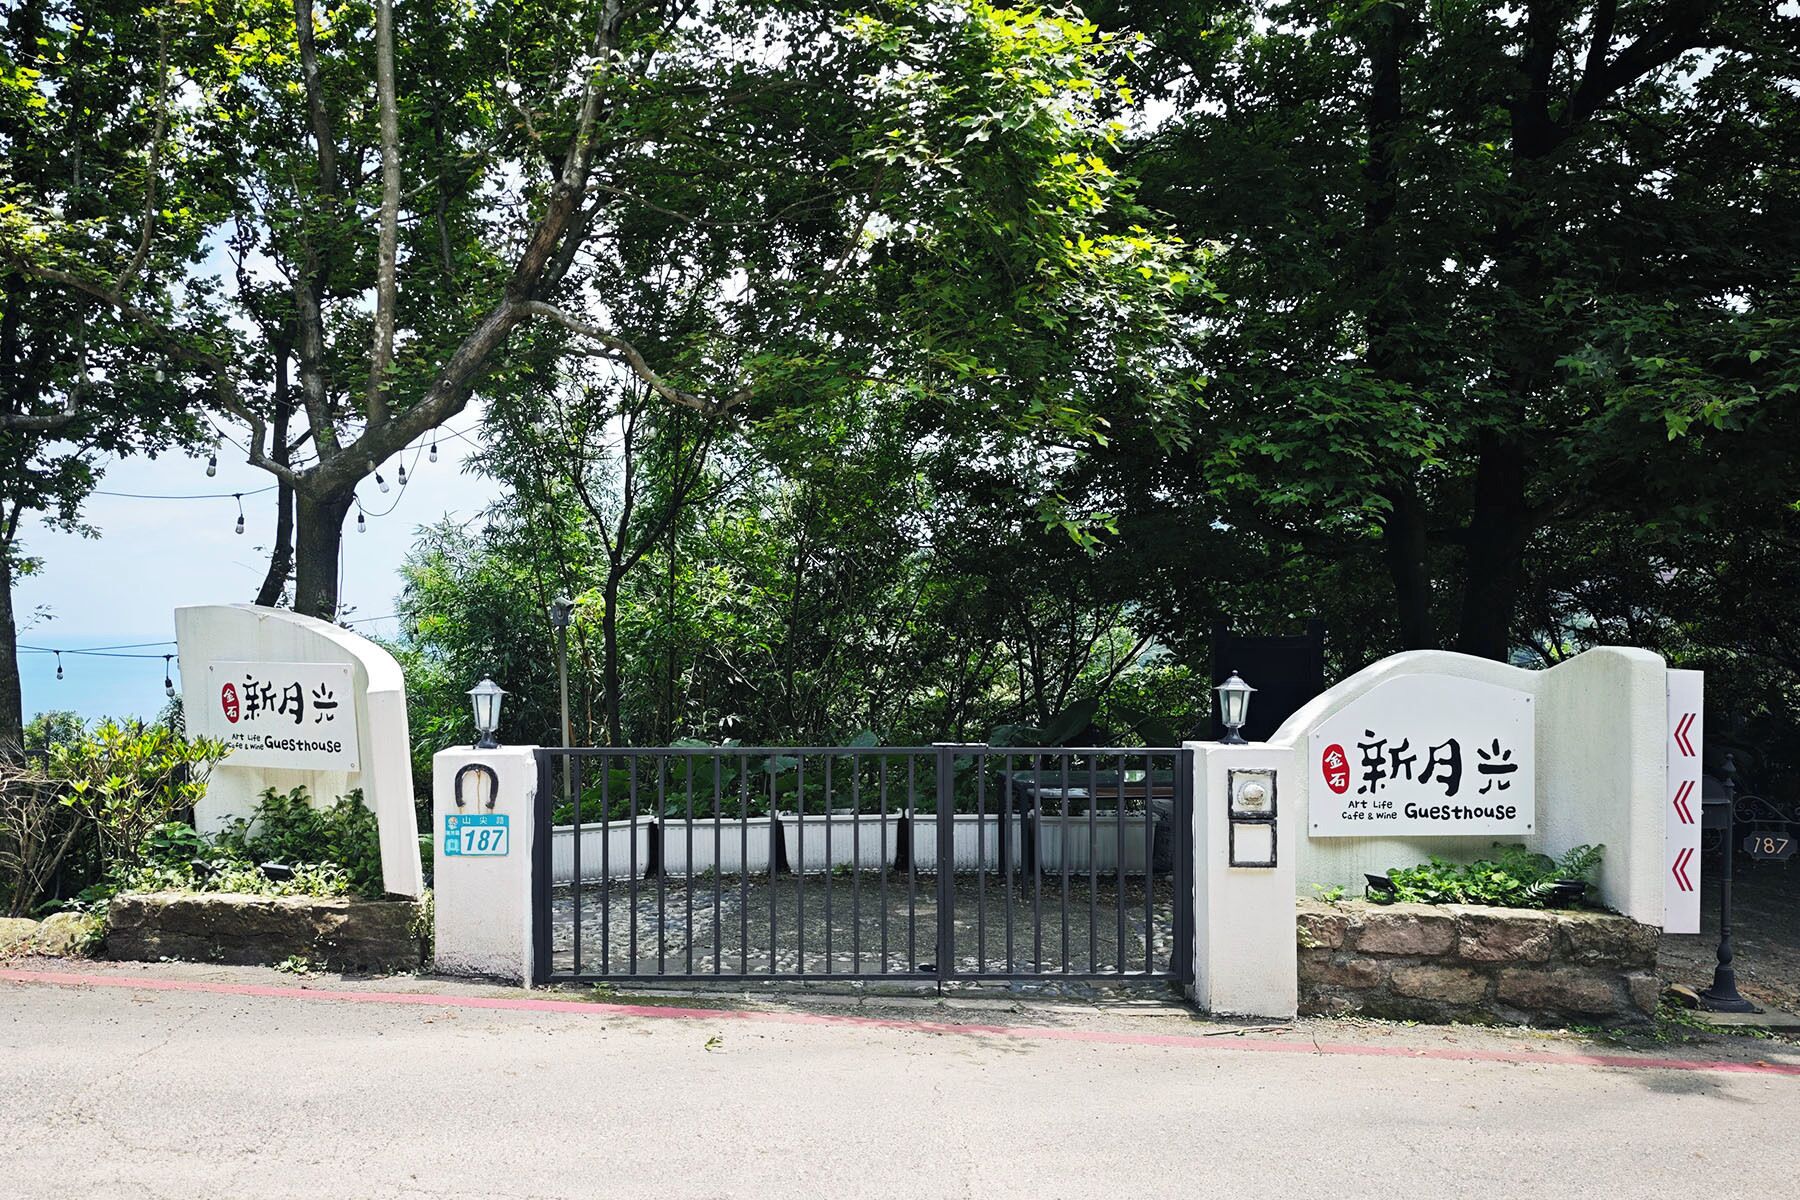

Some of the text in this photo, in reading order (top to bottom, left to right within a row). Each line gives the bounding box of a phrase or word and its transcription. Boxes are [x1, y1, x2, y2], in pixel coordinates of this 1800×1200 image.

[223, 688, 237, 718] 金石
[242, 674, 338, 725] 新月光
[231, 733, 261, 742] Art Life
[264, 735, 341, 753] Guesthouse
[1324, 750, 1347, 788] 金石
[1357, 729, 1518, 797] 新月光
[1348, 800, 1393, 809] Art Life
[1404, 802, 1516, 820] Guesthouse
[1341, 811, 1365, 820] Cafe
[1367, 812, 1374, 820] &
[465, 829, 504, 852] 187
[1753, 837, 1789, 854] 187
